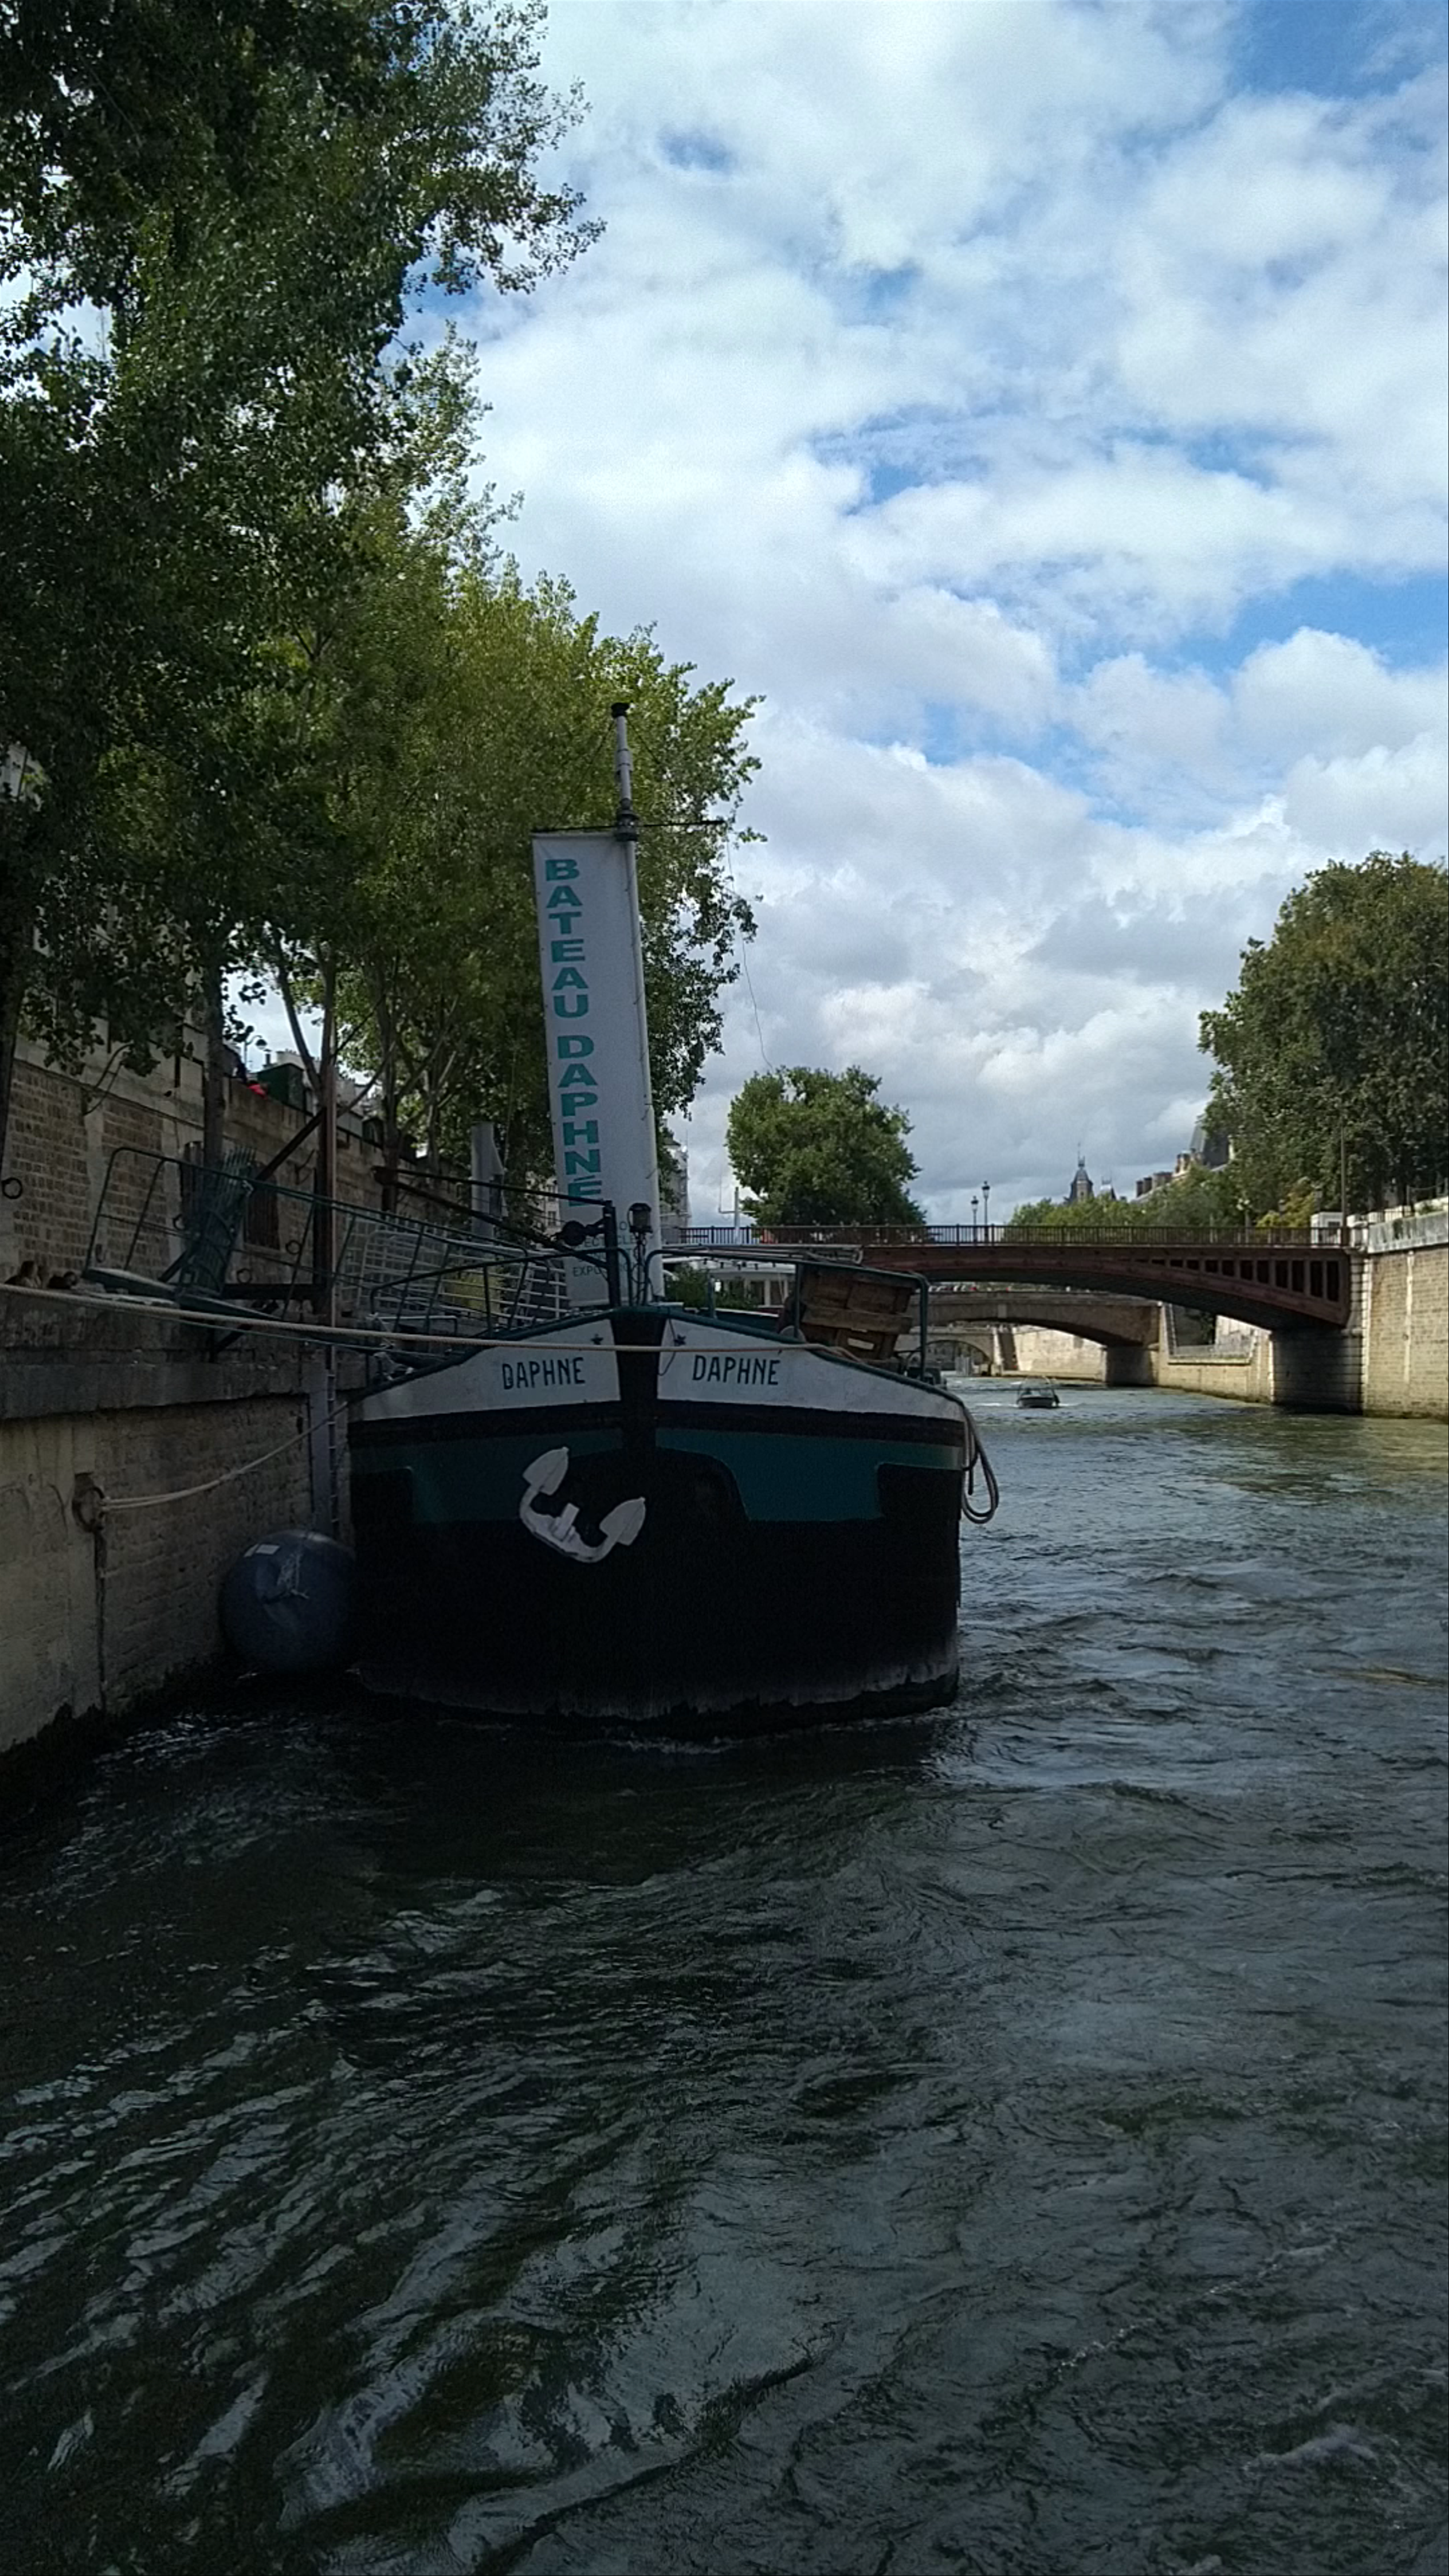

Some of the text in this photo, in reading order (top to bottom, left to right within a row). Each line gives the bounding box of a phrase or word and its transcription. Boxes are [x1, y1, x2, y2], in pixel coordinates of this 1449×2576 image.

[545, 859, 589, 1018] BATEAU
[502, 1357, 586, 1390] DAPHNE
[692, 1355, 780, 1385] DAPHNE
